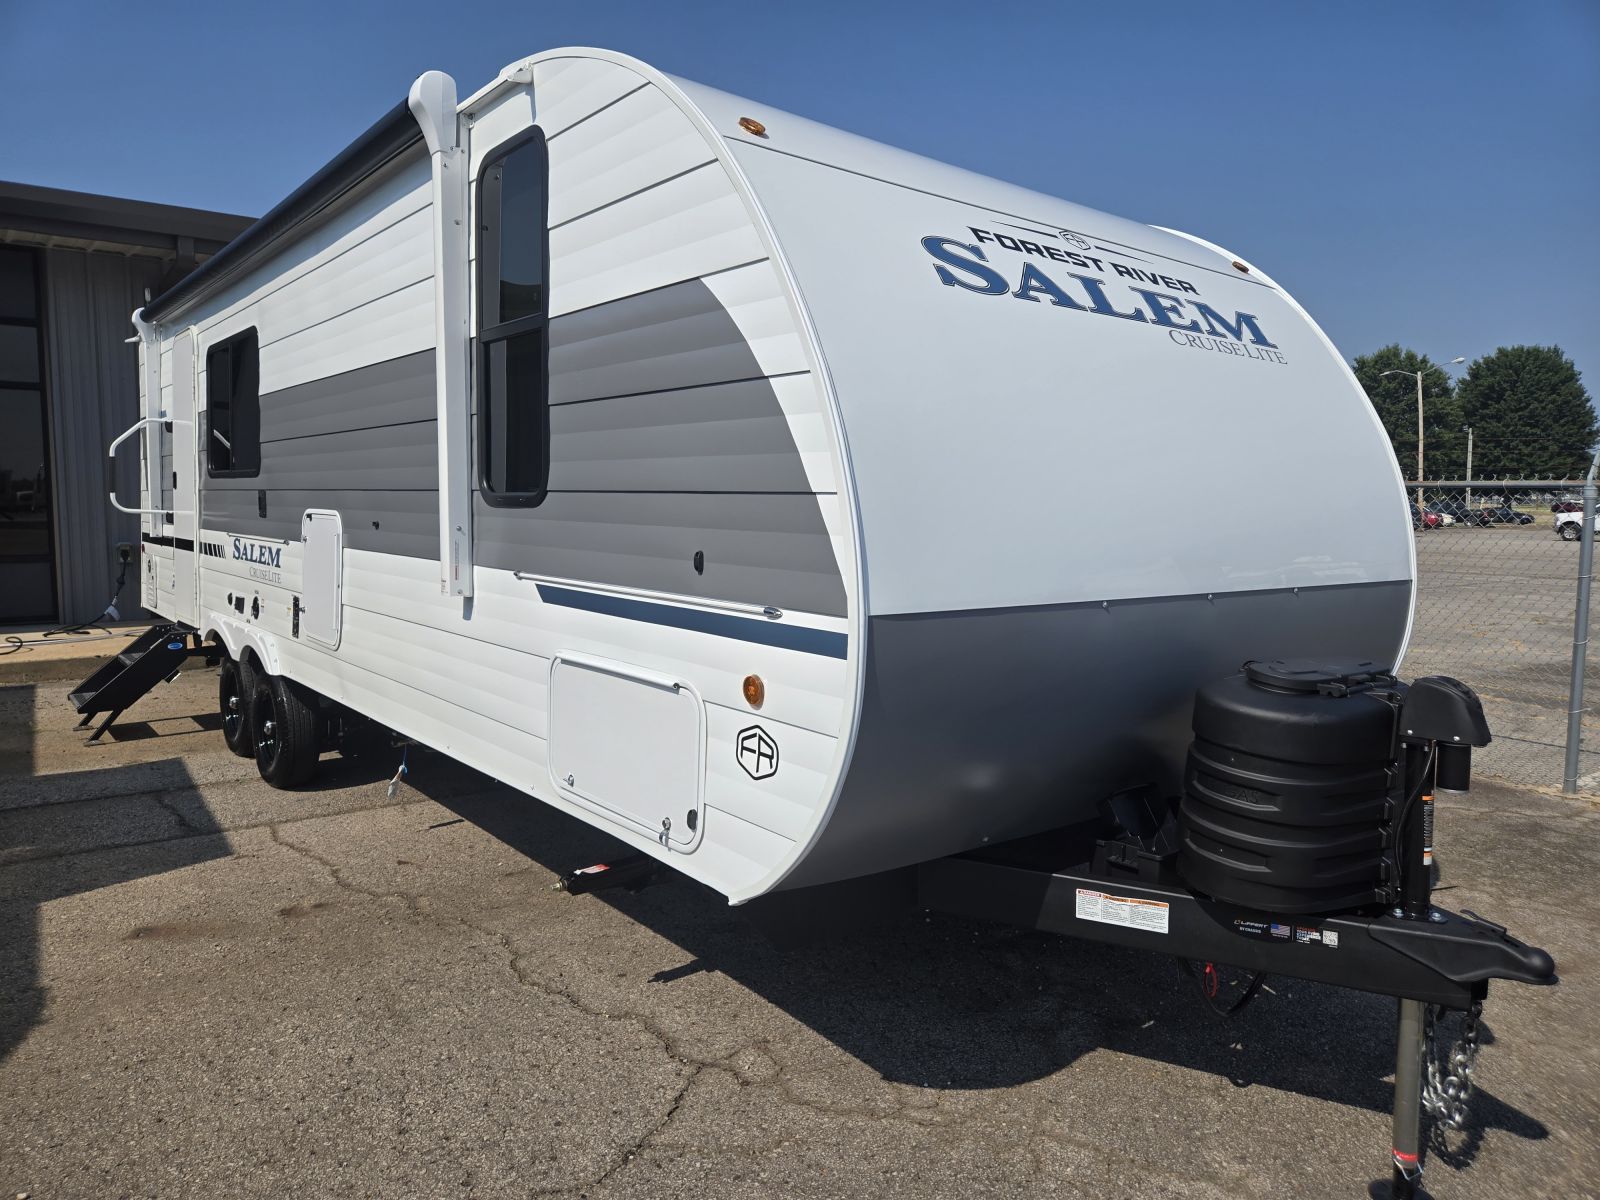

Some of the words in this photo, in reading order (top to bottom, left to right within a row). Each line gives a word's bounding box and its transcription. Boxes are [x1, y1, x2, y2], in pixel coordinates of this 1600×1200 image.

[921, 235, 1279, 349] SALEM
[967, 226, 1105, 272] FOREST
[1108, 263, 1200, 296] RIVER
[233, 537, 281, 568] SALEM
